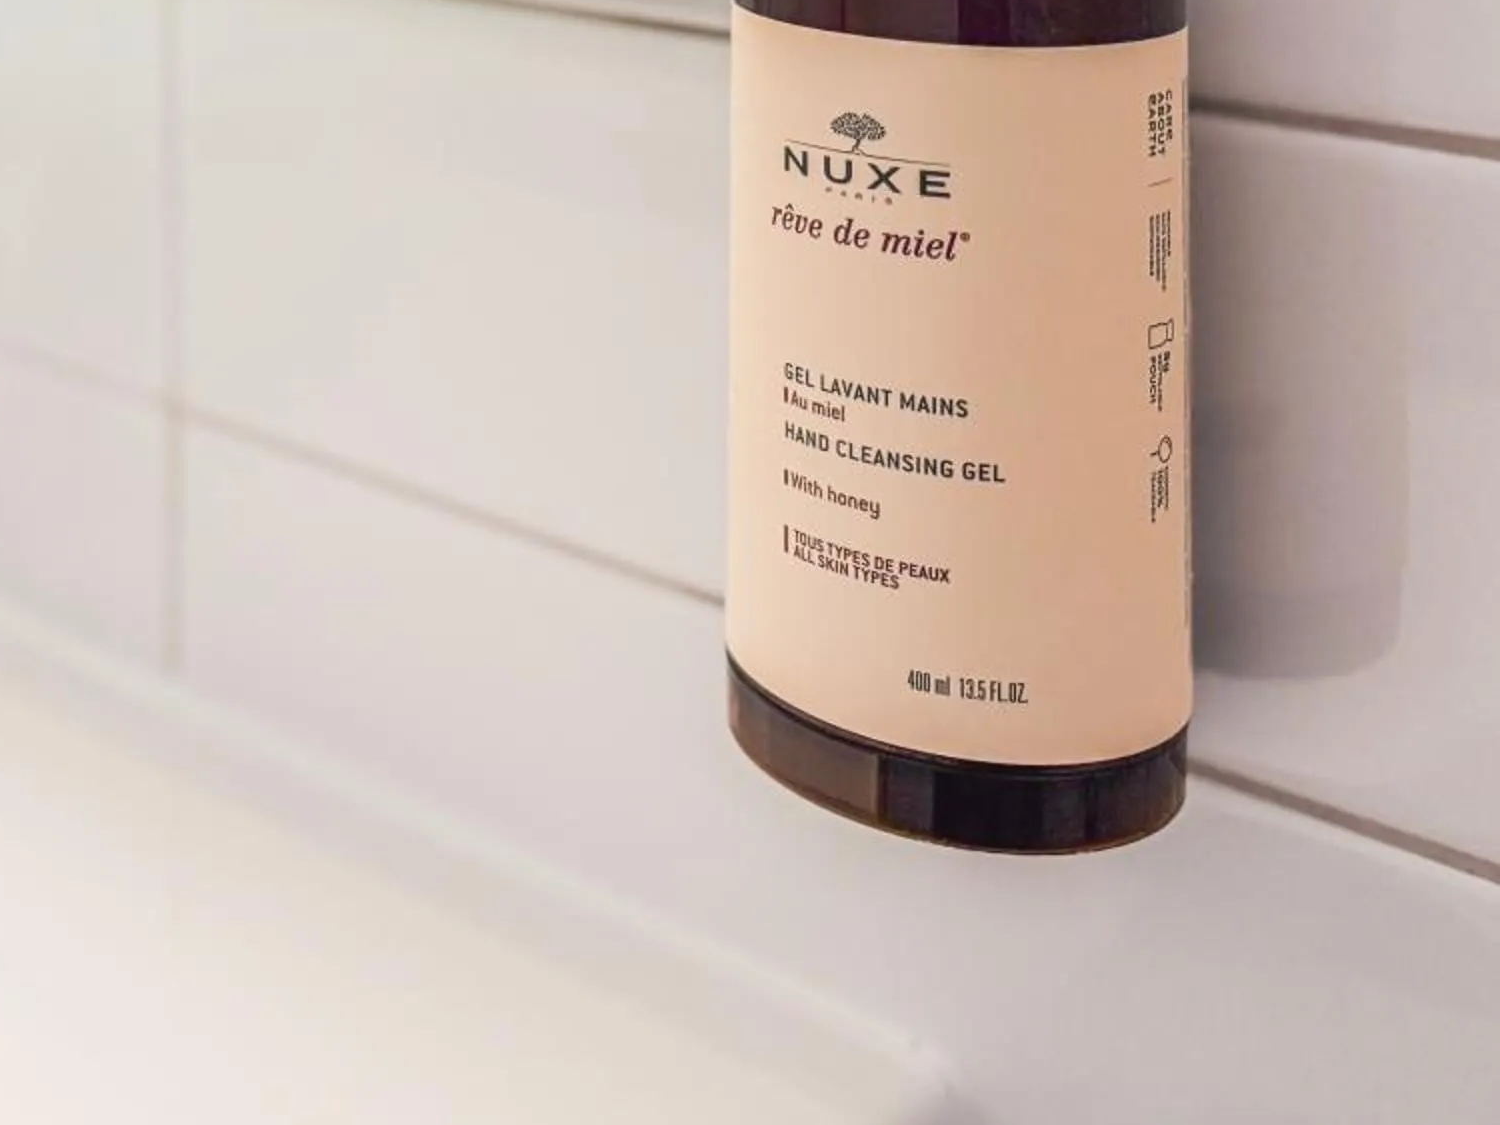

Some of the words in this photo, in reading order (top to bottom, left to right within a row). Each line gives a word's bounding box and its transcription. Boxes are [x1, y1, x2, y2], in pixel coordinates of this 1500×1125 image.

[1148, 94, 1156, 157] EARTH
[1165, 89, 1173, 141] CARE
[784, 146, 951, 198] NUXE
[771, 203, 823, 239] rêve
[833, 218, 870, 249] de
[784, 362, 814, 388] GEL
[820, 374, 893, 408] LAVANT
[899, 392, 969, 418] MAINS
[791, 389, 807, 410] Au
[811, 401, 845, 422] miel
[785, 421, 830, 452] HAND
[836, 439, 954, 478] CLEANSING
[962, 462, 1006, 483] GEL
[791, 471, 823, 499] With
[828, 486, 881, 520] honey
[794, 529, 824, 552] TOUS
[828, 542, 870, 568] TYPES
[874, 556, 894, 573] DE
[899, 561, 950, 584] PEAUX
[794, 545, 814, 566] ALL
[818, 554, 849, 576] SKIN
[854, 566, 899, 589] TYPES
[908, 669, 931, 693] 400
[934, 676, 951, 696] ml
[960, 677, 986, 700] 13.5
